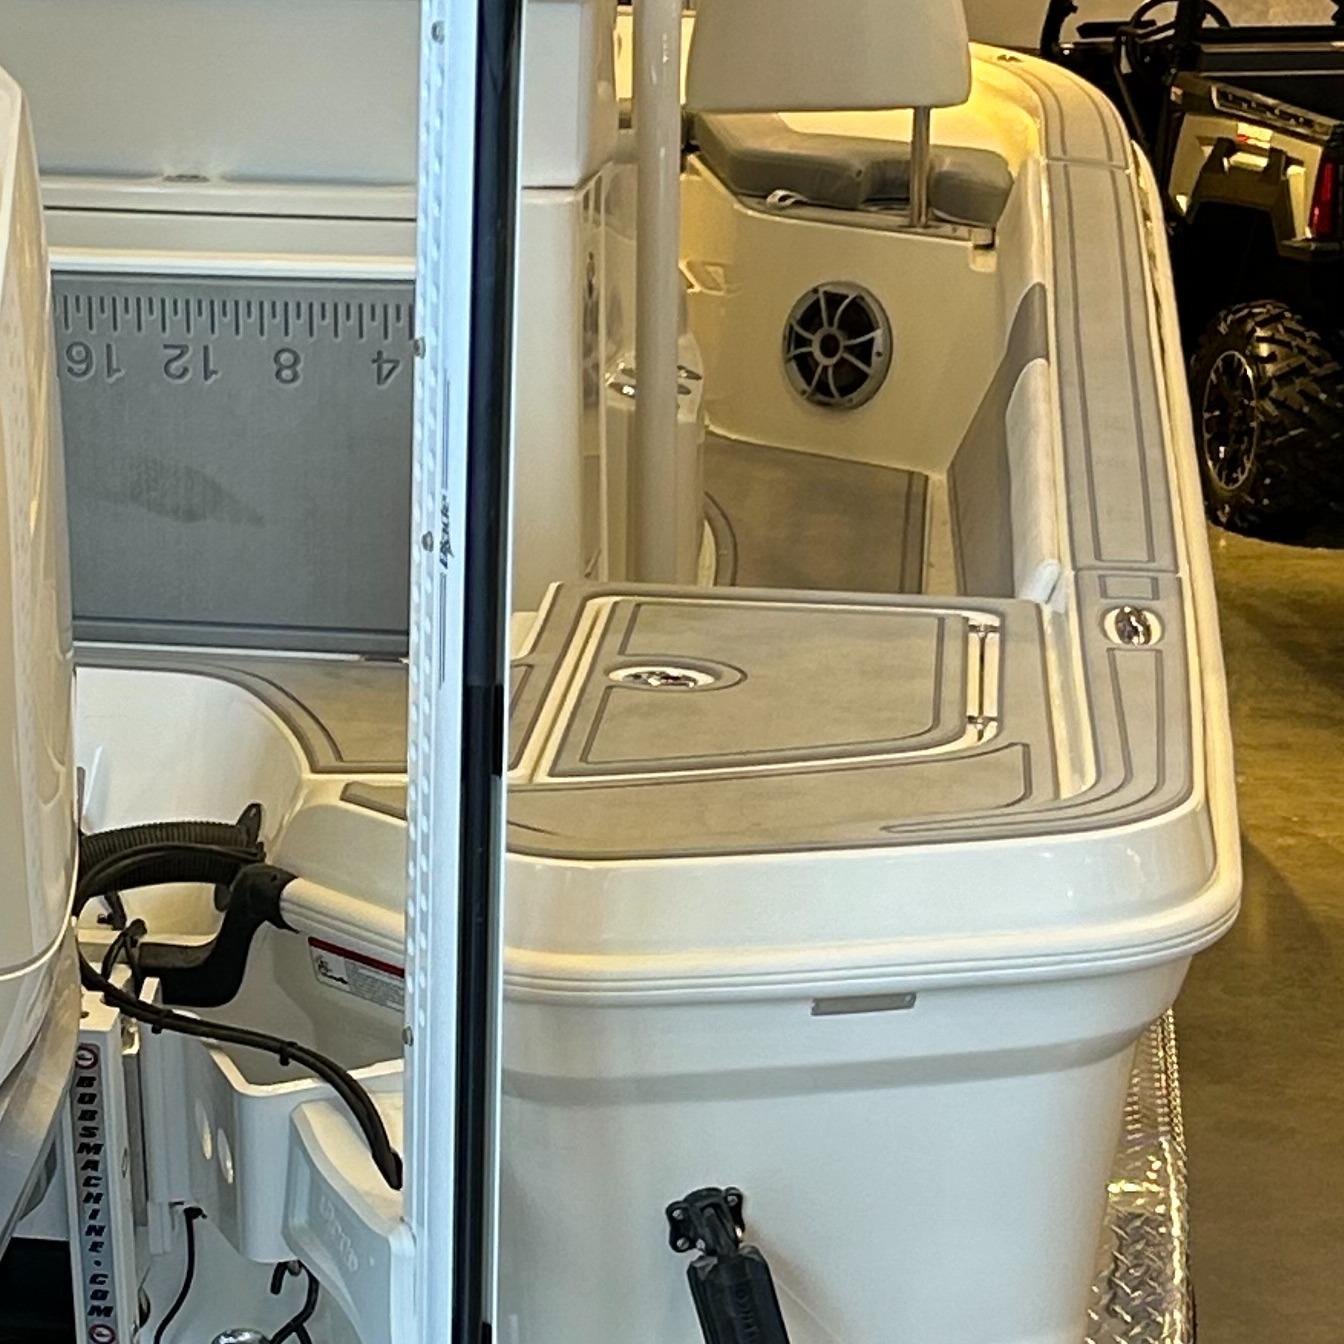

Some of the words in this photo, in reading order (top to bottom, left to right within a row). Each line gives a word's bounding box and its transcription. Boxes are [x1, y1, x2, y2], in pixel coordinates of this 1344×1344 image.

[65, 340, 124, 380] 16
[162, 342, 220, 383] 12
[273, 346, 301, 385] 8
[372, 349, 401, 386] 4
